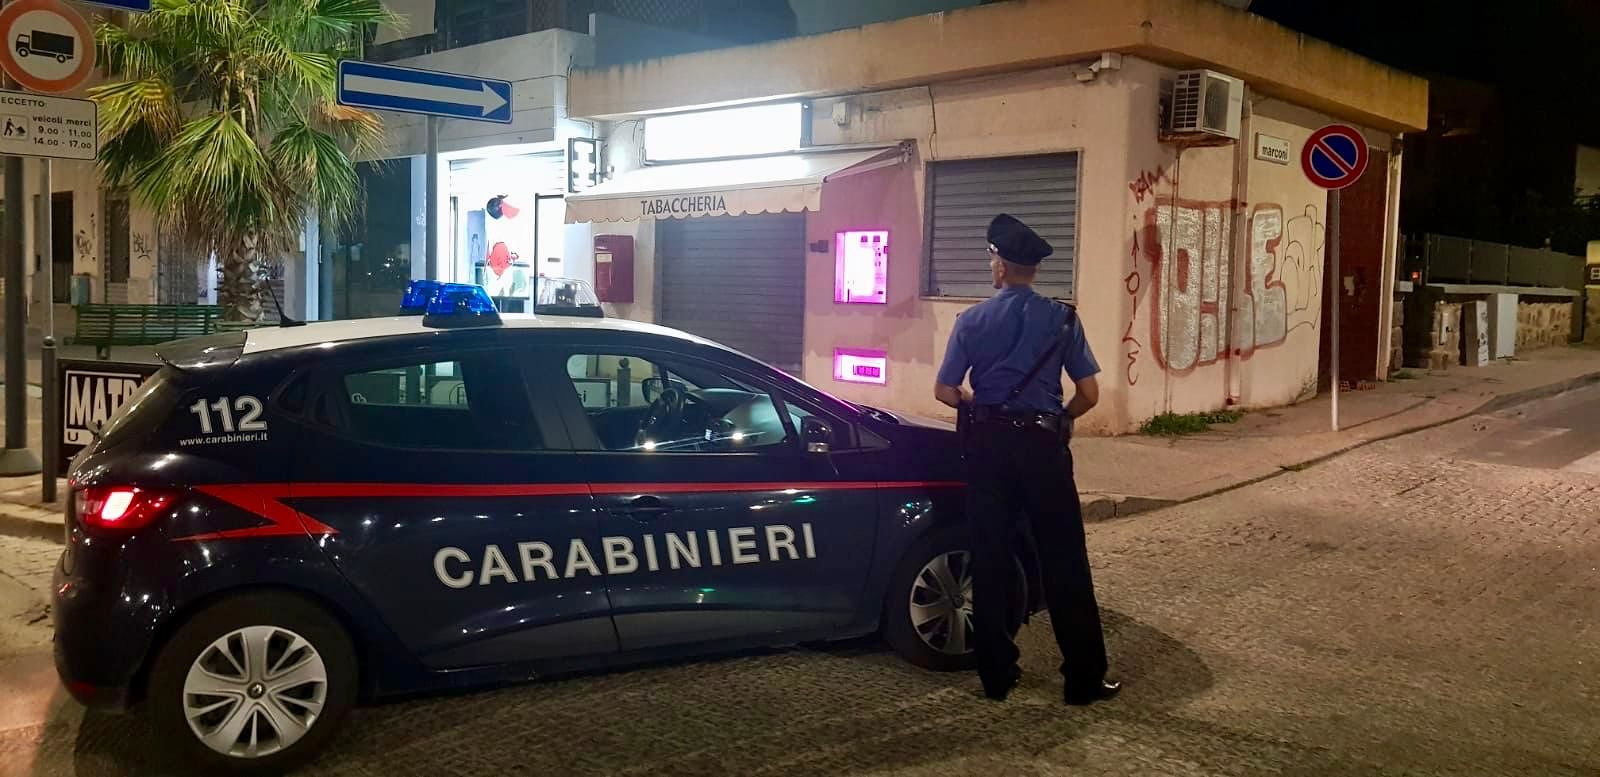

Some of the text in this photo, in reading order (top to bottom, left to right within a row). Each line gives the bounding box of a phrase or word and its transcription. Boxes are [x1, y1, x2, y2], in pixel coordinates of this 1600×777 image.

[33, 115, 62, 125] veicoli
[38, 126, 58, 135] 9.00
[69, 129, 92, 138] 11.00
[69, 140, 92, 149] 17.00
[641, 195, 726, 215] TABACCHERIA
[190, 395, 267, 433] 112
[180, 432, 268, 446] www.carabinieri.it
[433, 522, 817, 589] CARABINIERI
